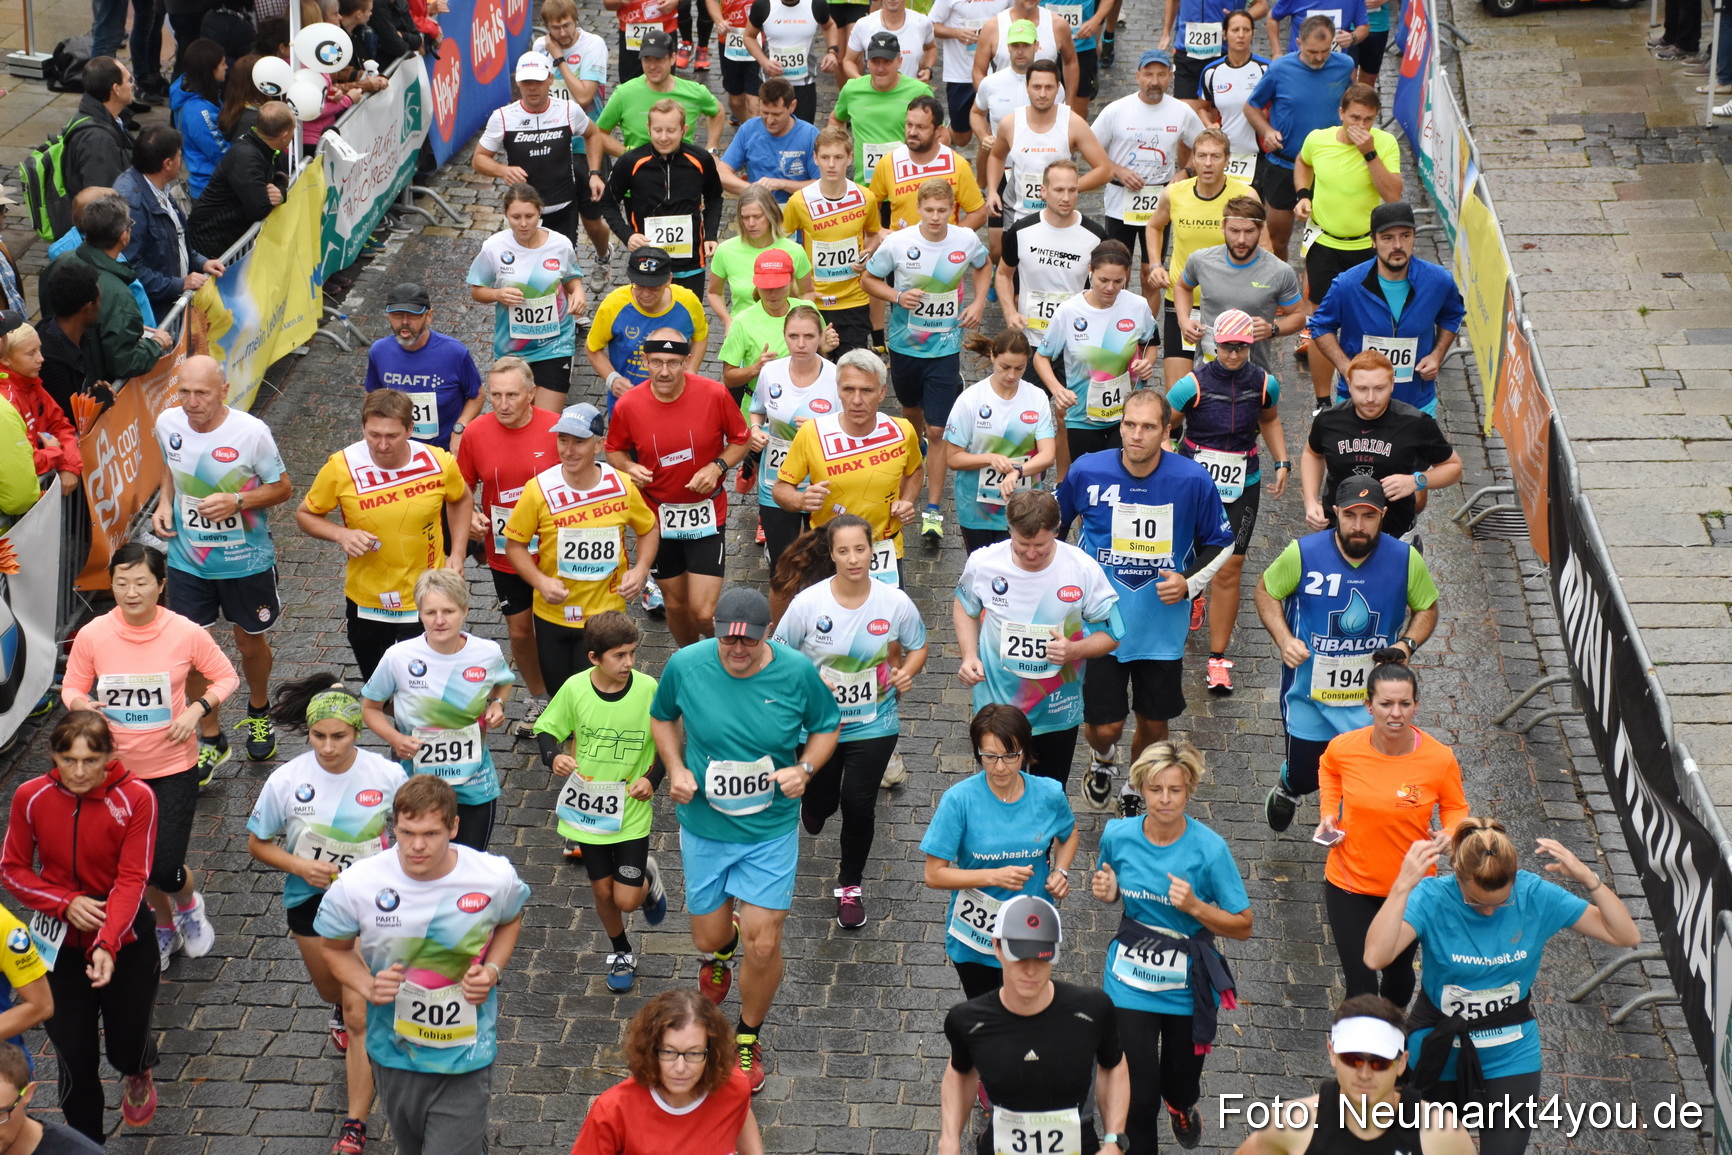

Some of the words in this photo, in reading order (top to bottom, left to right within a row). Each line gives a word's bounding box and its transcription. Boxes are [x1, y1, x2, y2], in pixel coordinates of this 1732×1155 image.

[472, 4, 507, 68] Hervis
[729, 36, 745, 49] 26
[1189, 31, 1219, 47] 2281
[433, 56, 463, 127] Hervis
[867, 154, 882, 169] 27
[895, 183, 921, 196] MAX
[1133, 196, 1160, 212] 252
[813, 218, 839, 231] MAX
[841, 210, 868, 227] BÖGL
[1178, 218, 1221, 227] KLINGE
[655, 227, 689, 246] 262
[817, 248, 855, 267] 2702
[1037, 247, 1082, 263] INTERSPORT
[1038, 257, 1072, 270] HÄCKL
[826, 269, 850, 279] Yannik
[514, 304, 554, 325] 3027
[914, 301, 954, 318] 2443
[520, 323, 553, 336] SARAH
[922, 319, 943, 328] Julian
[383, 371, 431, 388] CRAFT
[811, 401, 830, 411] Hervis
[1101, 387, 1122, 408] 64
[412, 404, 432, 422] 31
[1337, 437, 1393, 458] FLORIDA
[769, 448, 788, 469] 22
[825, 460, 866, 477] MAX
[868, 445, 906, 470] BÖGL
[1354, 454, 1375, 463] TECH
[358, 491, 401, 511] MAX
[403, 477, 446, 500] BÖGL
[1086, 484, 1122, 508] 14
[553, 509, 590, 530] MAX
[592, 498, 630, 524] BÖGL
[664, 504, 713, 529] 2793
[198, 533, 228, 543] Ludwig
[1131, 518, 1157, 541] 10
[564, 541, 616, 562] 2688
[1129, 542, 1156, 553] Simon
[571, 563, 605, 574] Andreas
[868, 550, 890, 572] 87
[1117, 568, 1153, 577] BASKETS
[1304, 570, 1342, 598] 21
[991, 596, 1010, 605] PARTL
[1060, 589, 1081, 600] Hervis
[869, 622, 890, 633] Hervis
[1006, 635, 1056, 659] 255
[1311, 635, 1389, 653] FIBALON
[1018, 662, 1049, 677] Roland
[1326, 668, 1365, 689] 194
[105, 687, 165, 707] 2701
[1048, 691, 1063, 702] 17.
[1320, 691, 1365, 704] Constantin
[125, 712, 149, 722] Chen
[840, 710, 861, 719] mara
[419, 739, 474, 765] 2591
[434, 767, 463, 779] Ulrike
[713, 771, 769, 798] 3066
[564, 787, 619, 815] 2643
[293, 806, 315, 815] PARTL
[580, 814, 597, 827] Jan
[972, 848, 1043, 861] www.hasit.de
[461, 898, 490, 911] Hervis
[376, 915, 401, 923] PARTL
[959, 898, 1000, 935] 232
[970, 930, 993, 949] Petra
[1451, 949, 1528, 967] www.hasit.de
[1131, 966, 1166, 984] Antonia
[411, 1000, 461, 1027] 202
[417, 1027, 453, 1041] Tobias
[1012, 1128, 1065, 1154] 312
